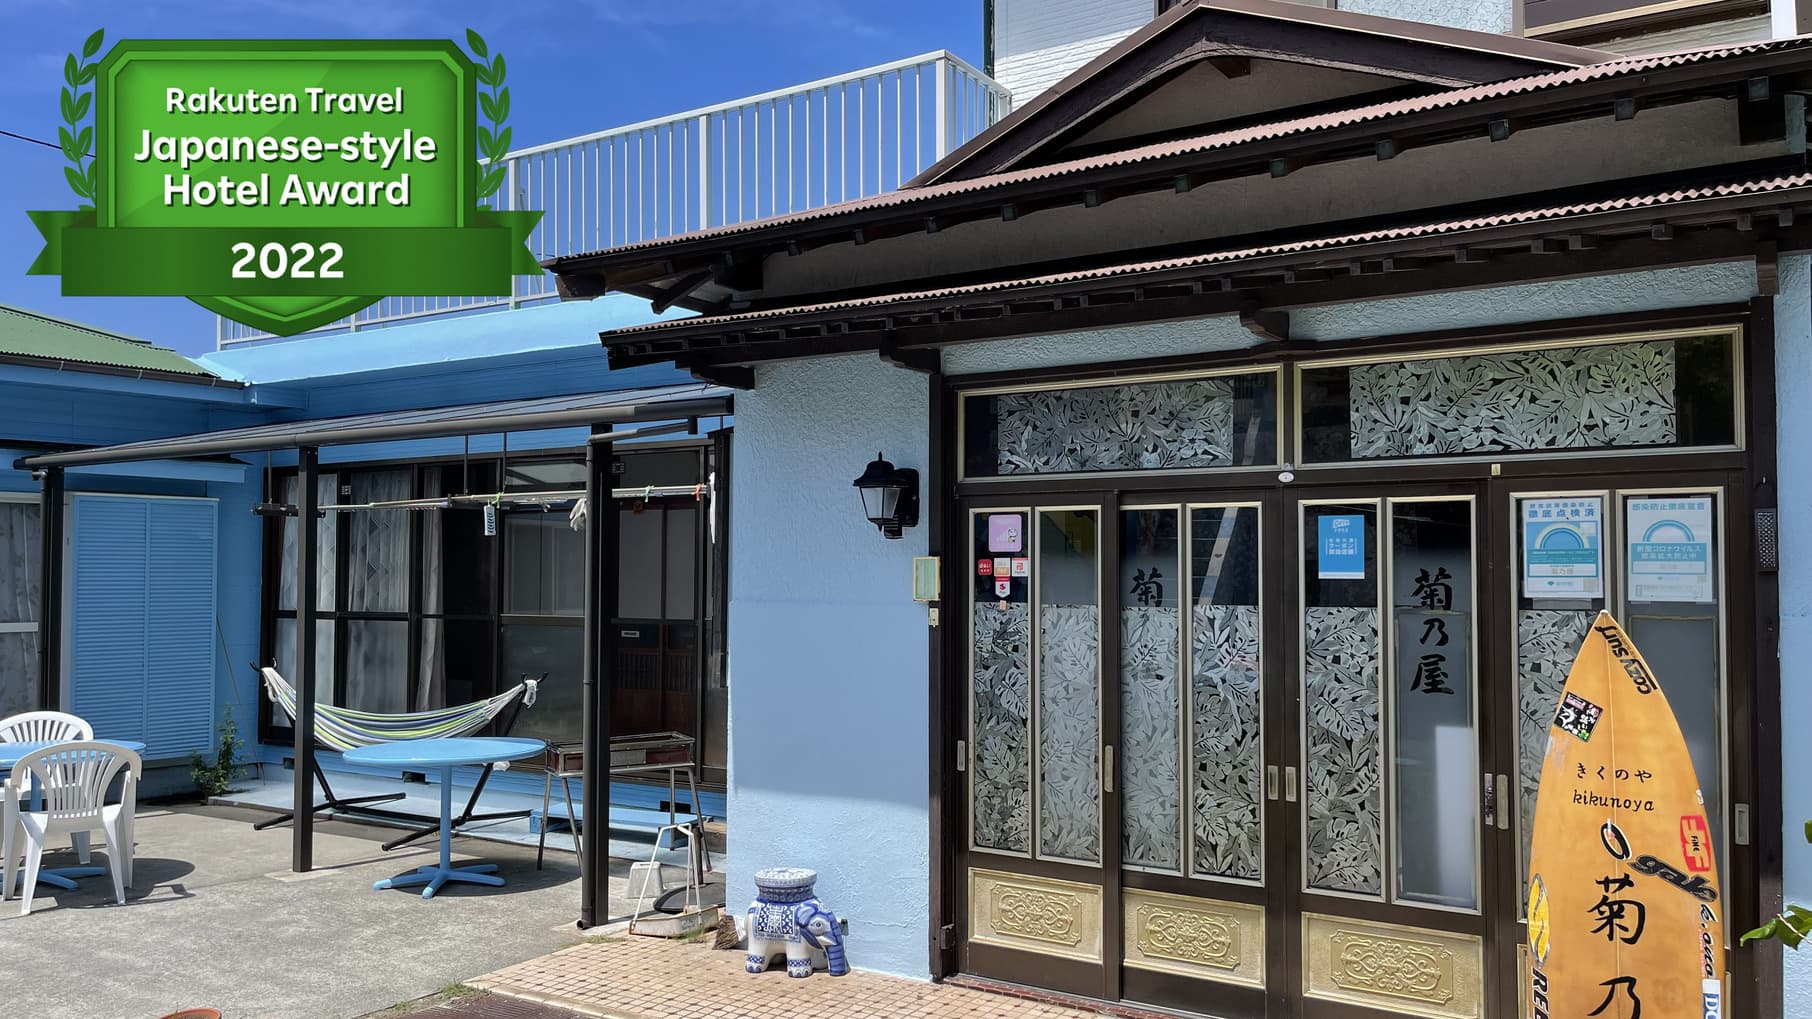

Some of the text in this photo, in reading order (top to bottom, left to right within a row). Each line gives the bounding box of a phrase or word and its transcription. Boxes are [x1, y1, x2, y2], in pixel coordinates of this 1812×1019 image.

[1129, 566, 1164, 607] 菊
[1409, 566, 1455, 695] 菊乃屋
[1577, 762, 1653, 783] きくのや
[1572, 789, 1655, 813] kikunoya
[1586, 872, 1646, 1018] 菊乃
